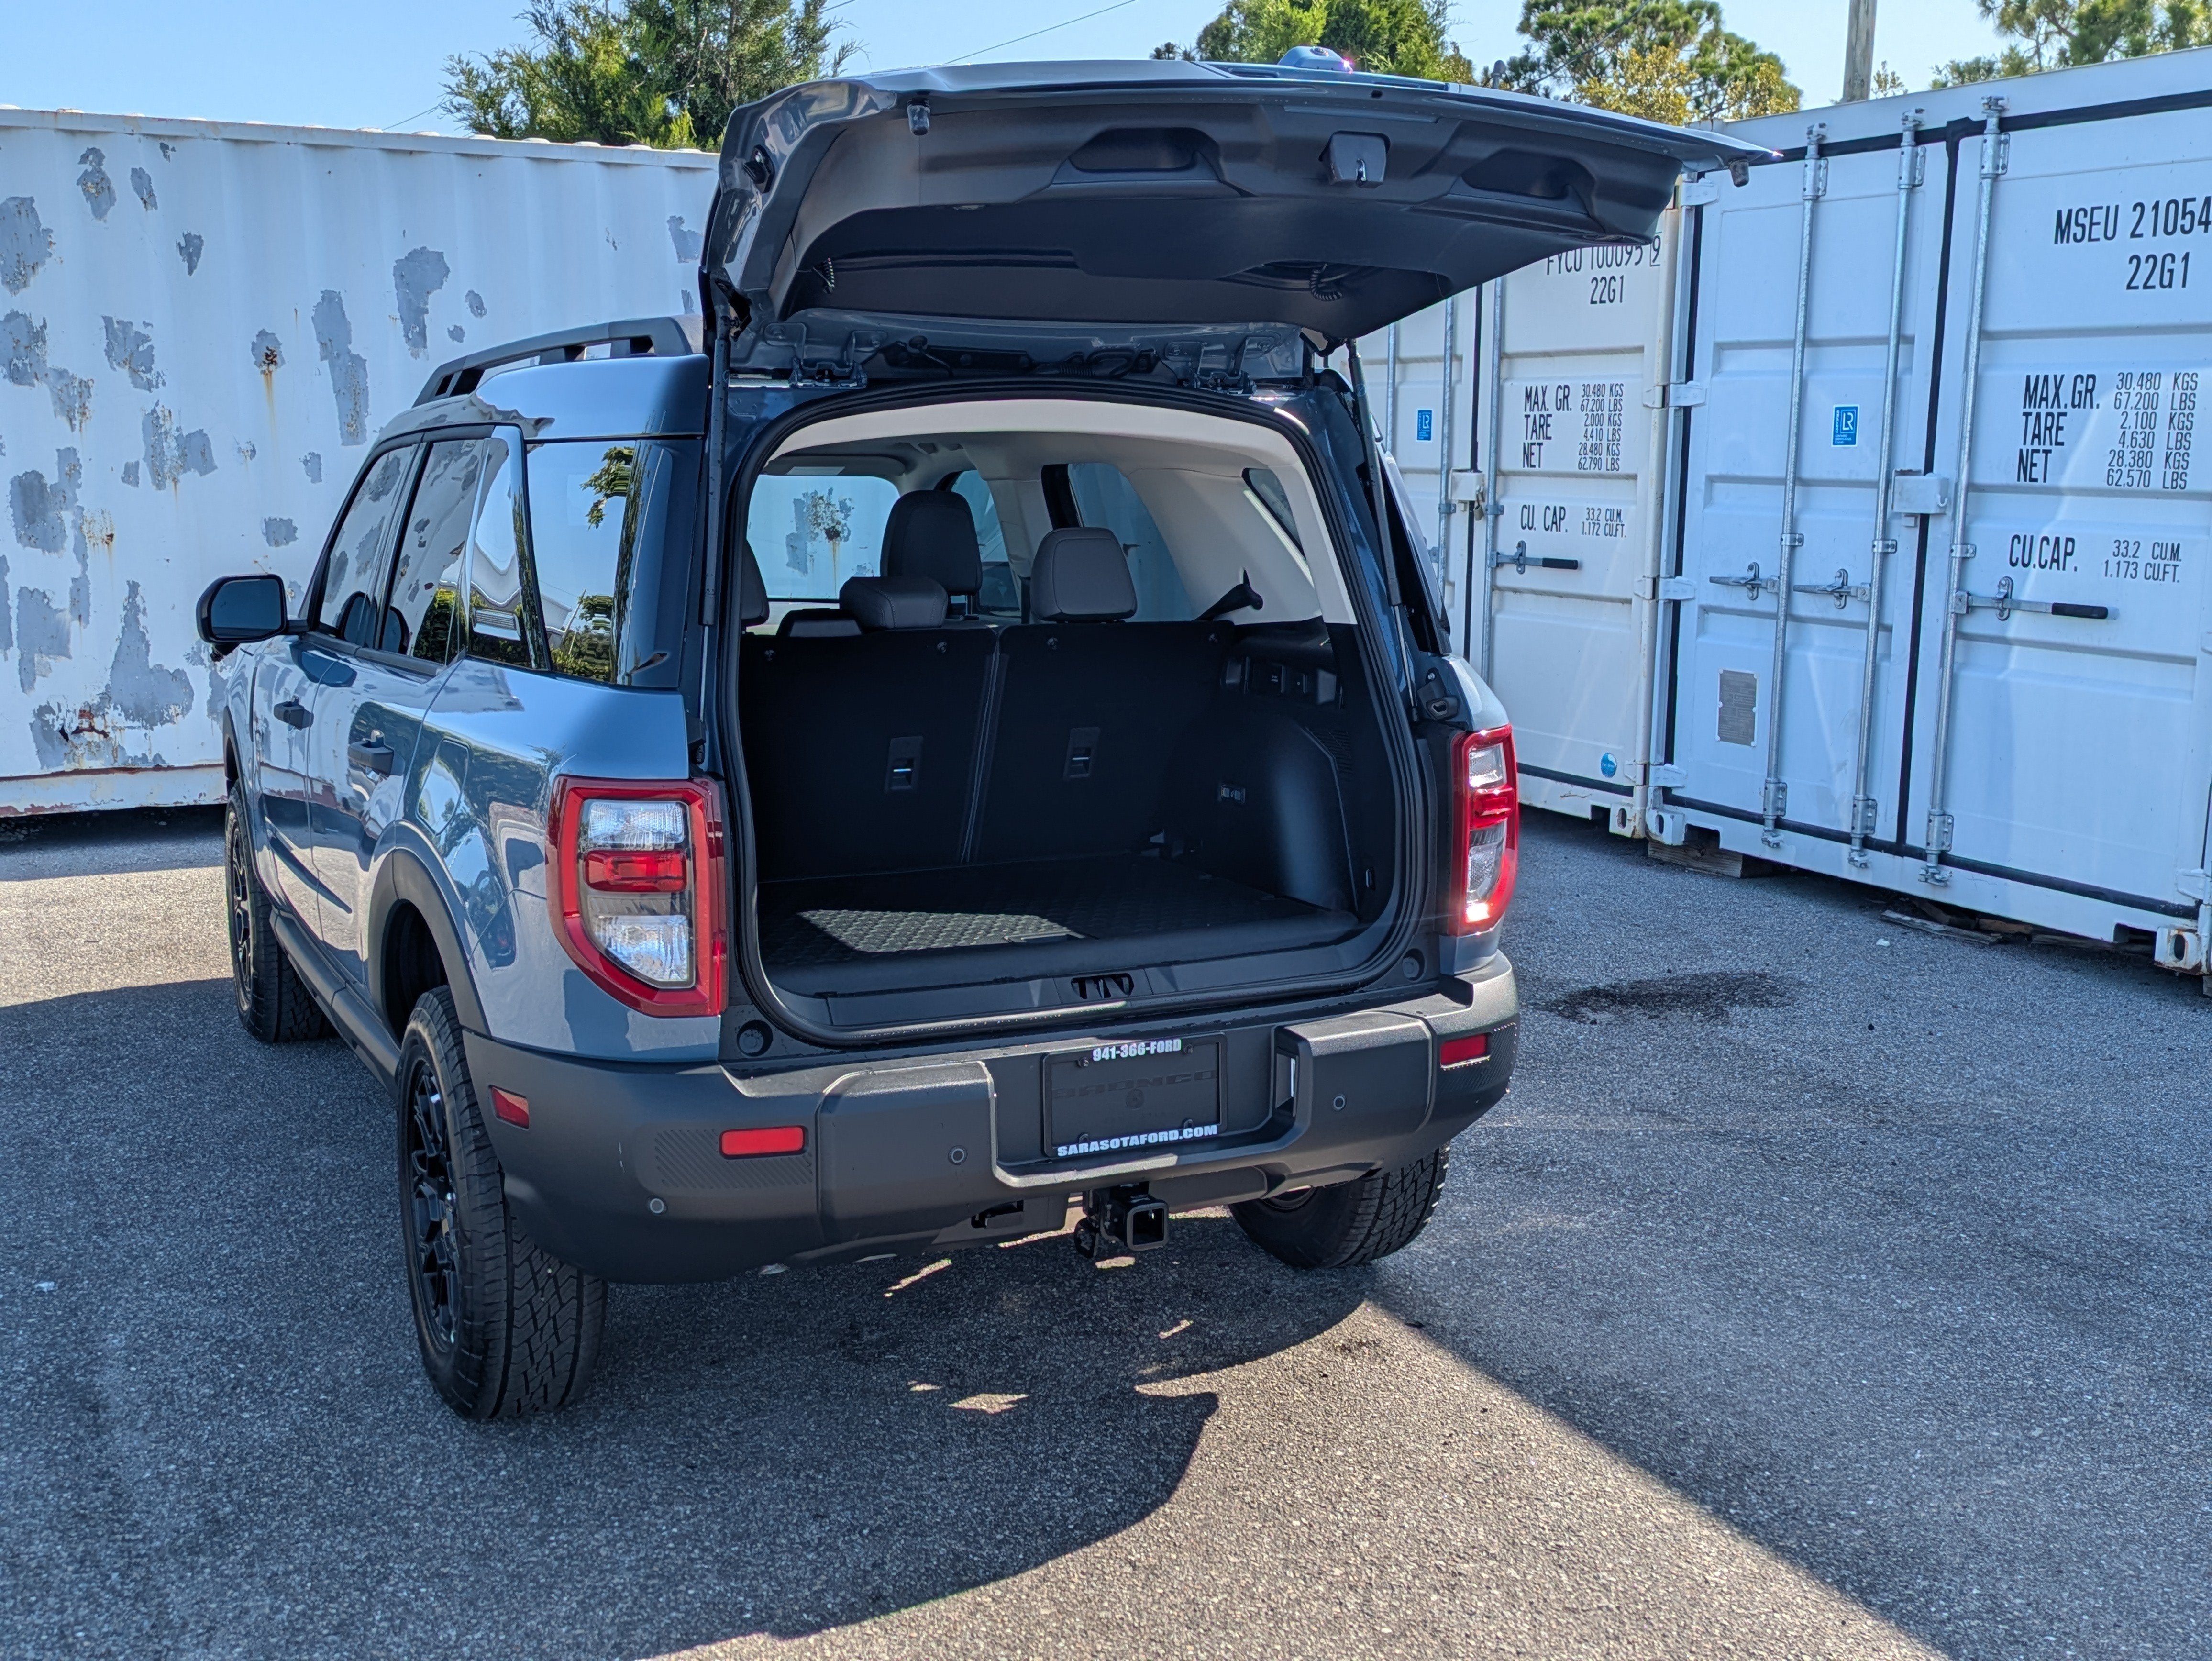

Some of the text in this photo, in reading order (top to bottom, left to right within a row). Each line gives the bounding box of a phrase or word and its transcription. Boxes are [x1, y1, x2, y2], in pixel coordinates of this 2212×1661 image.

[2054, 196, 2212, 244] MSEU 21054
[2126, 251, 2190, 290] 22G1
[1590, 275, 1624, 304] 22G1
[1609, 383, 1624, 397] KGS
[2116, 372, 2198, 391] 30,480 KGS
[1524, 385, 1572, 412] MAX. GR.
[1608, 398, 1623, 412] LBS
[2114, 392, 2196, 411] 67,200 LBS
[1524, 414, 1553, 440] TARE
[1607, 413, 1622, 427] KGS
[2022, 412, 2067, 446] TARE
[2120, 411, 2194, 431] 2,100 KGS
[1607, 428, 1621, 442] LBS
[2118, 431, 2192, 451] 4,630 LBS
[1523, 442, 1544, 468] NET
[1606, 443, 1621, 456] KGS
[2108, 449, 2190, 470] 28,380 KGS
[1606, 457, 1620, 471] LBS
[2017, 449, 2052, 483] NET
[2107, 468, 2188, 490] 62,570 LBS
[1521, 504, 1568, 533] CU. CAP.
[1586, 507, 1602, 521] 33.2
[2112, 539, 2182, 562] 33.2 CU.M.
[2144, 562, 2180, 583] CU.FT.
[1092, 1038, 1182, 1062] 941-366-FORD
[1052, 1070, 1218, 1098] BRONCO
[1057, 1124, 1217, 1157] SARASOTAFORD.COM
